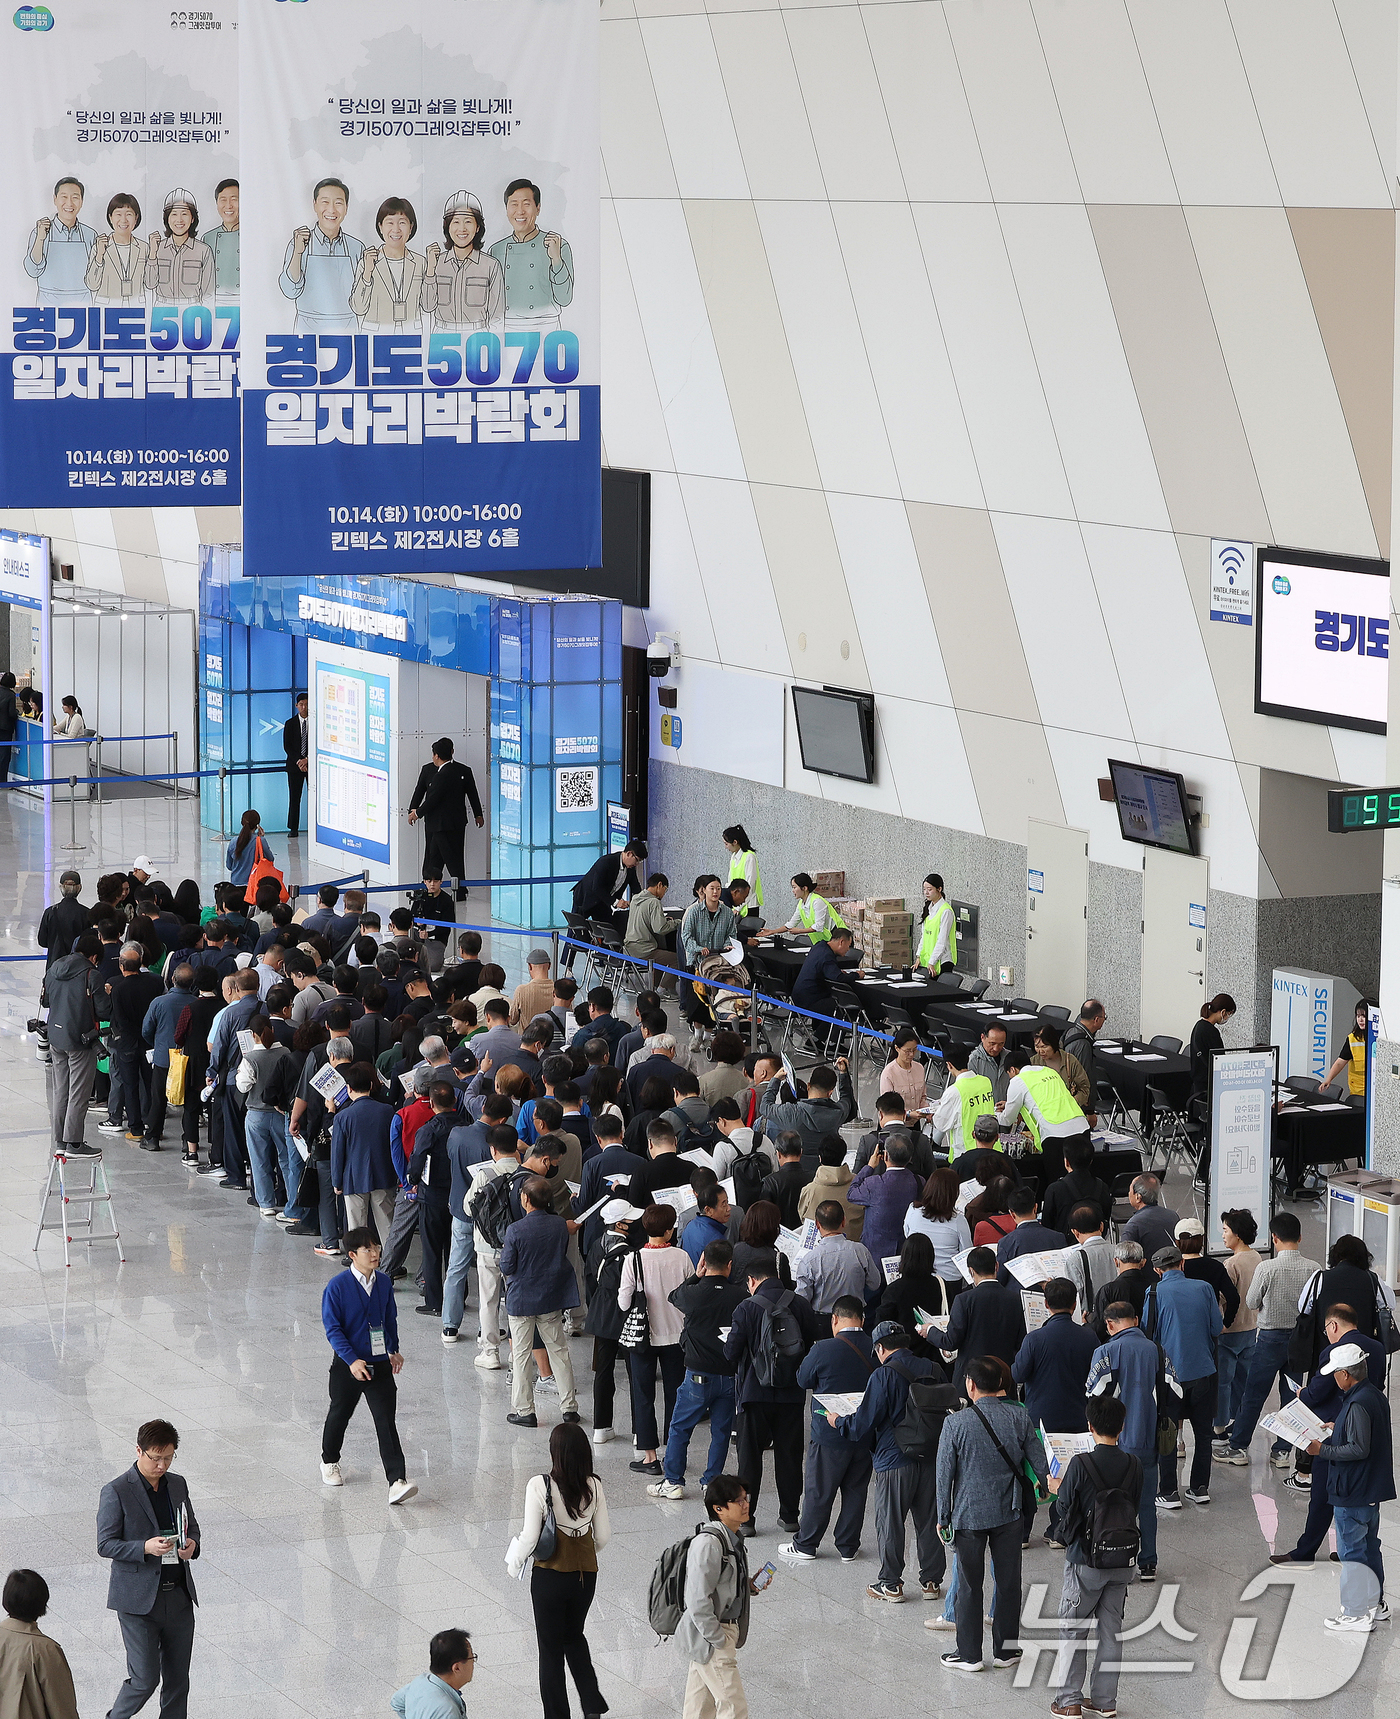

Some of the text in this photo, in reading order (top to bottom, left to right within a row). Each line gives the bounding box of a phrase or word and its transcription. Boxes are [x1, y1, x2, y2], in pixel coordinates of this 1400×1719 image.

[188, 11, 213, 21] 경기5070
[188, 21, 222, 30] 그레잇잡투어
[391, 98, 422, 115] 일과
[426, 98, 457, 115] 삶을
[462, 98, 513, 115] 빛나게!
[119, 111, 146, 125] 일과
[149, 111, 176, 125] 삶을
[179, 111, 222, 125] 빛나게!
[266, 330, 580, 387] 경기도5070
[12, 355, 241, 399] 일자리박람
[265, 389, 580, 446] 일자리박람회
[65, 448, 230, 465] 10.14.(화) 10:00~16:00
[68, 468, 228, 487] 킨텍스 제2전시장 6홀
[328, 502, 522, 525] 10.14.(화) 10:00~16:00
[331, 527, 520, 551] 킨텍스 제2전시장 6홀
[3, 557, 30, 578] 안내데스크
[1222, 614, 1240, 623] KINTEX
[1315, 609, 1389, 659] 경기도
[207, 670, 223, 688] 5070
[500, 740, 520, 761] 5070
[555, 736, 598, 746] 경기도5070
[1273, 978, 1308, 998] KINTEX
[1312, 988, 1328, 1079] SECURITY
